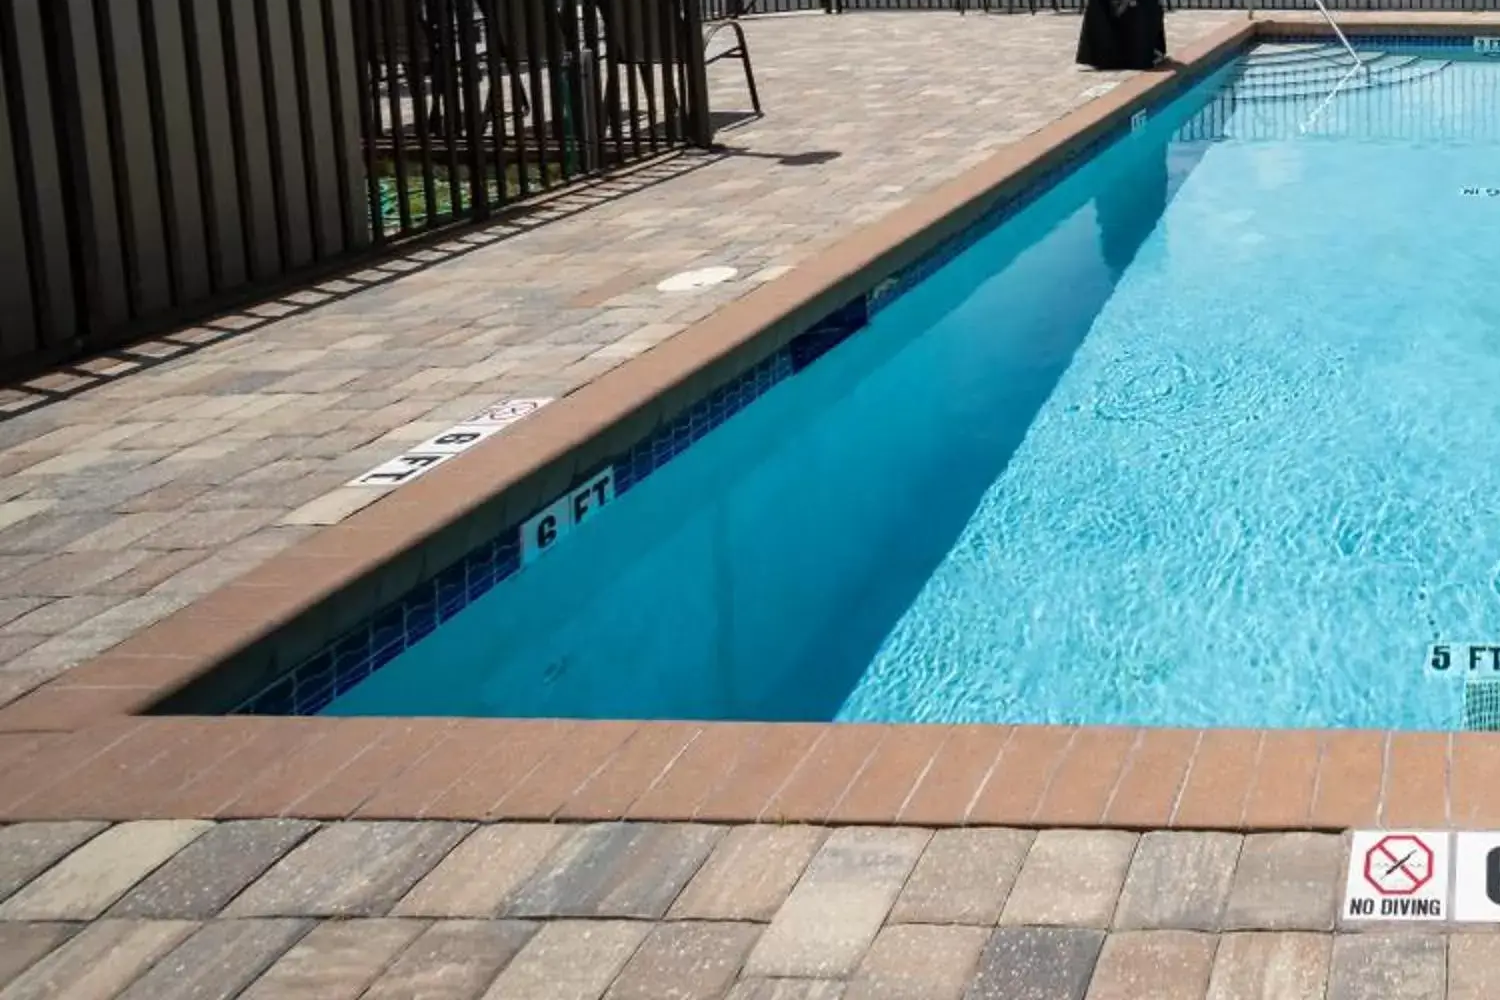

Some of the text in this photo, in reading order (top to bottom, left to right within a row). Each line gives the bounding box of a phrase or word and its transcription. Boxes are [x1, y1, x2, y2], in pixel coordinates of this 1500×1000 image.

[536, 514, 557, 549] 6
[1431, 646, 1450, 671] 5
[1349, 897, 1441, 917] NO DIVING
